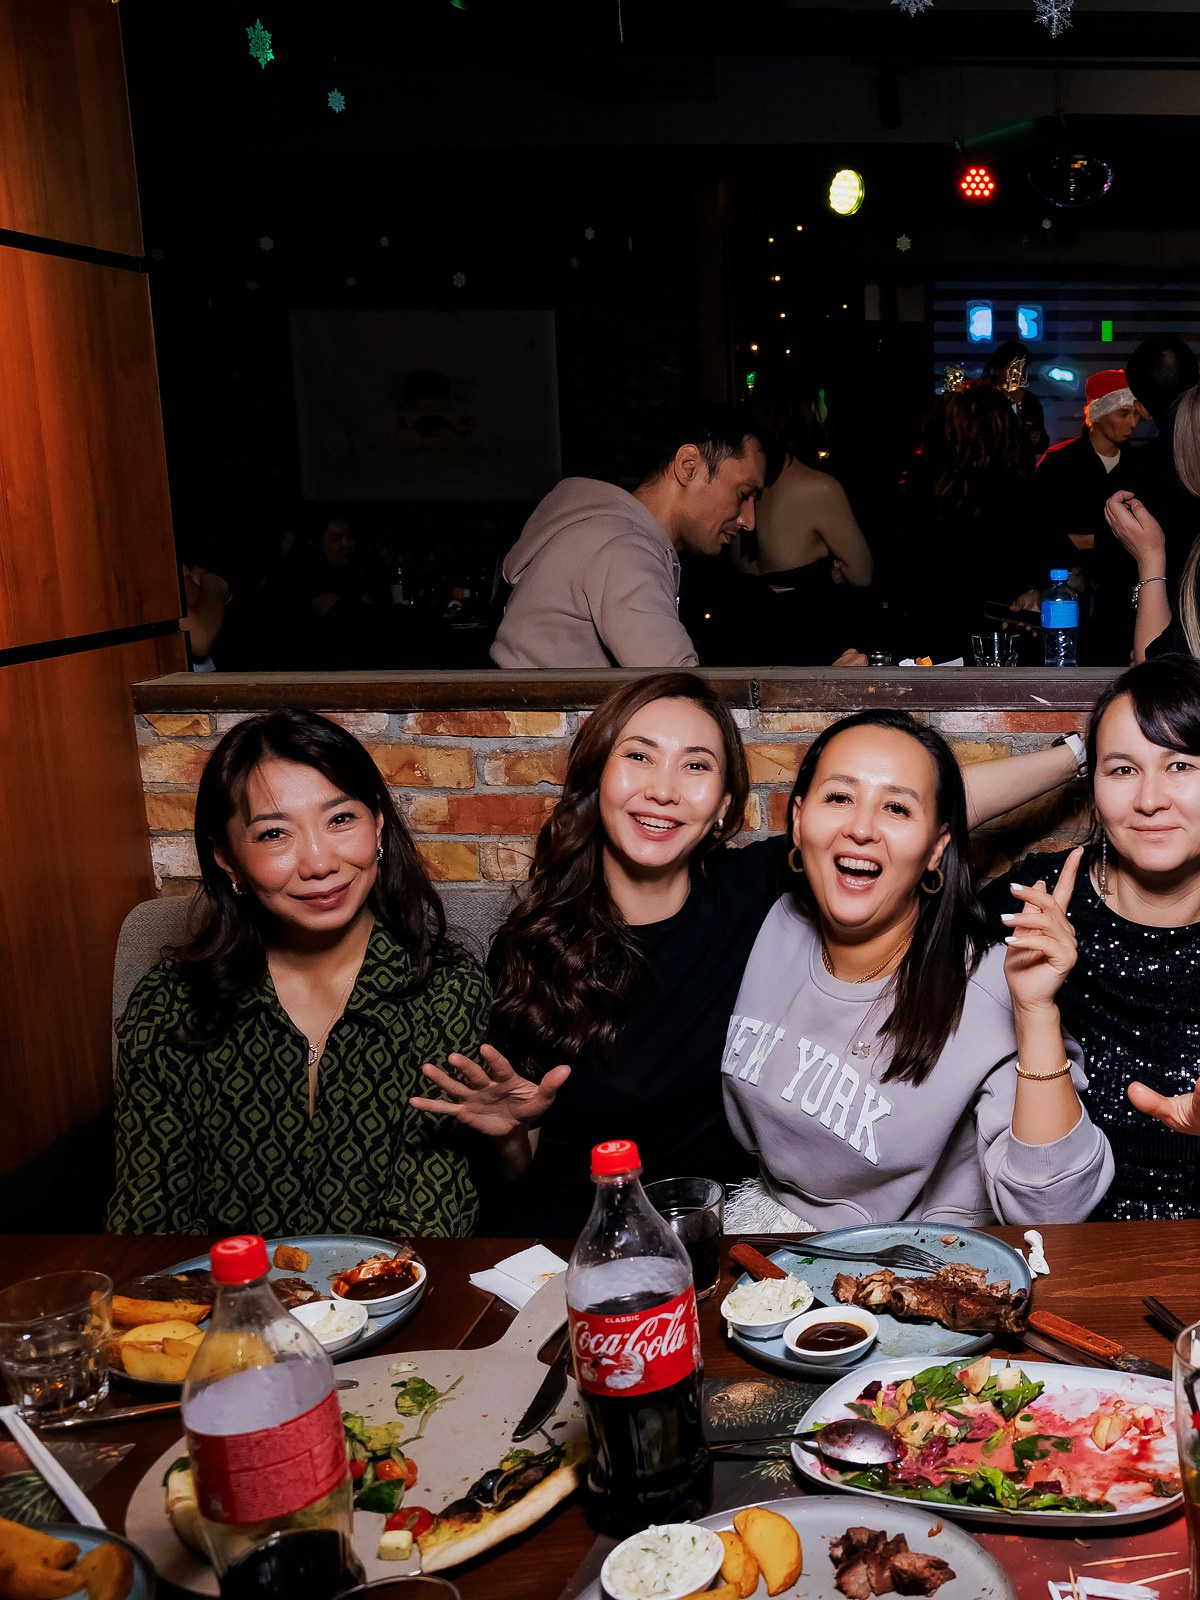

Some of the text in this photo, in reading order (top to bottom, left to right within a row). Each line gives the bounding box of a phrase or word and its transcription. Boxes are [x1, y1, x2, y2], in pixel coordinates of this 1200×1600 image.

[781, 1037, 893, 1165] YORK
[572, 1300, 688, 1362] Coca-Cola
[604, 1314, 640, 1324] CLASSIC
